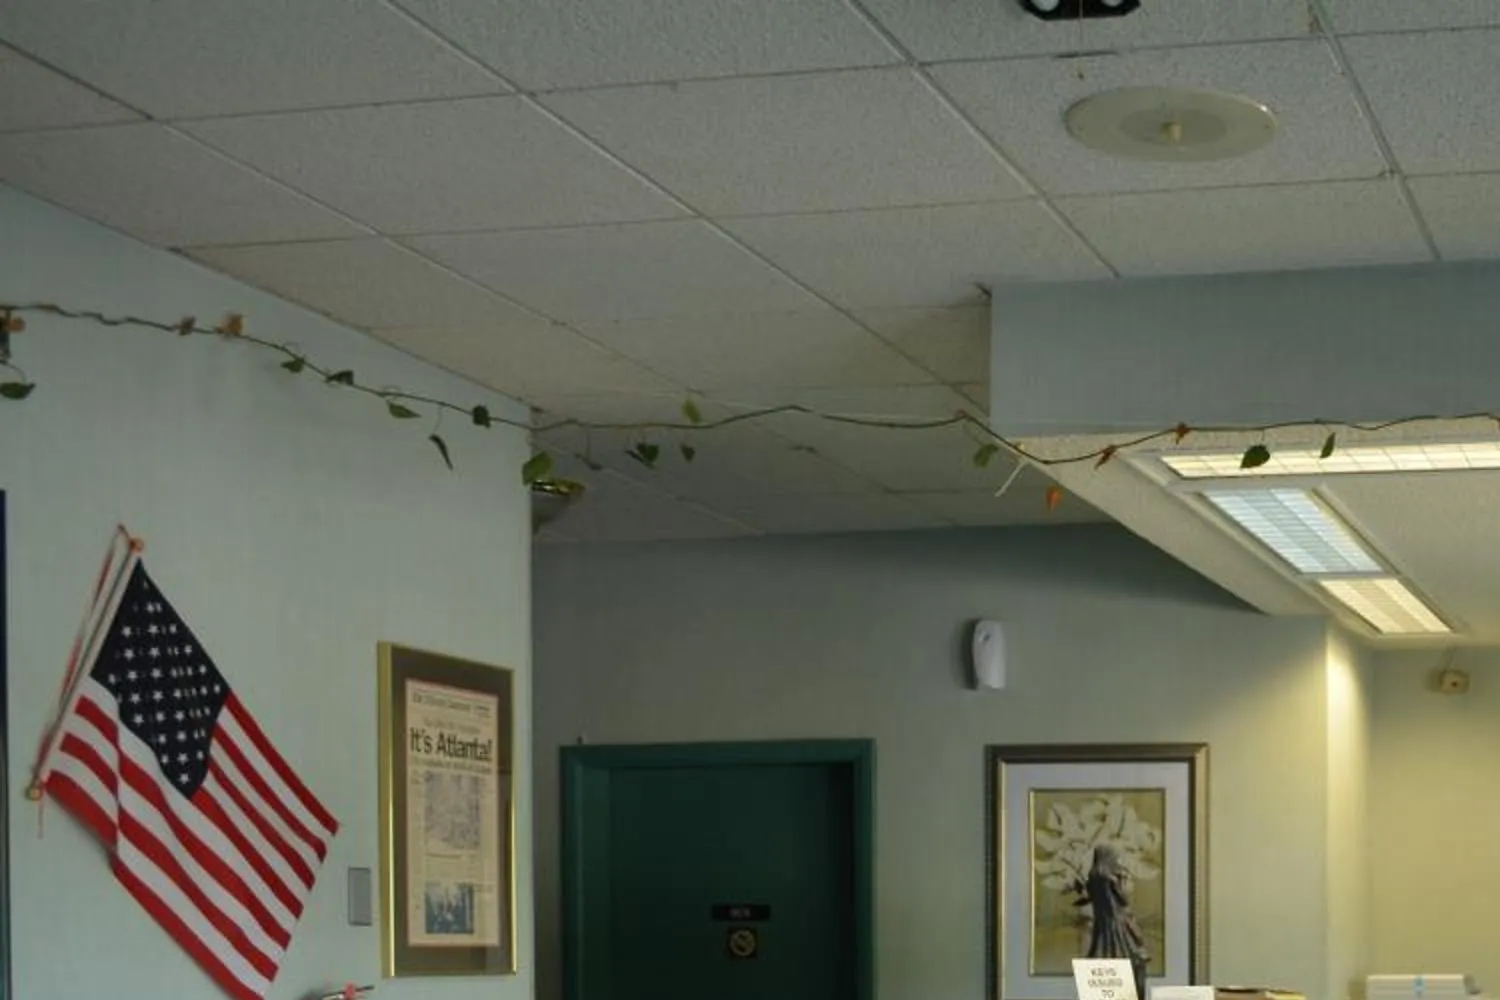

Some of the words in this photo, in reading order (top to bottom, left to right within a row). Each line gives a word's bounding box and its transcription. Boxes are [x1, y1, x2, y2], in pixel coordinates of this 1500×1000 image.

[410, 726, 433, 754] It's
[436, 731, 493, 763] Atlanta!
[1101, 989, 1115, 998] TO
